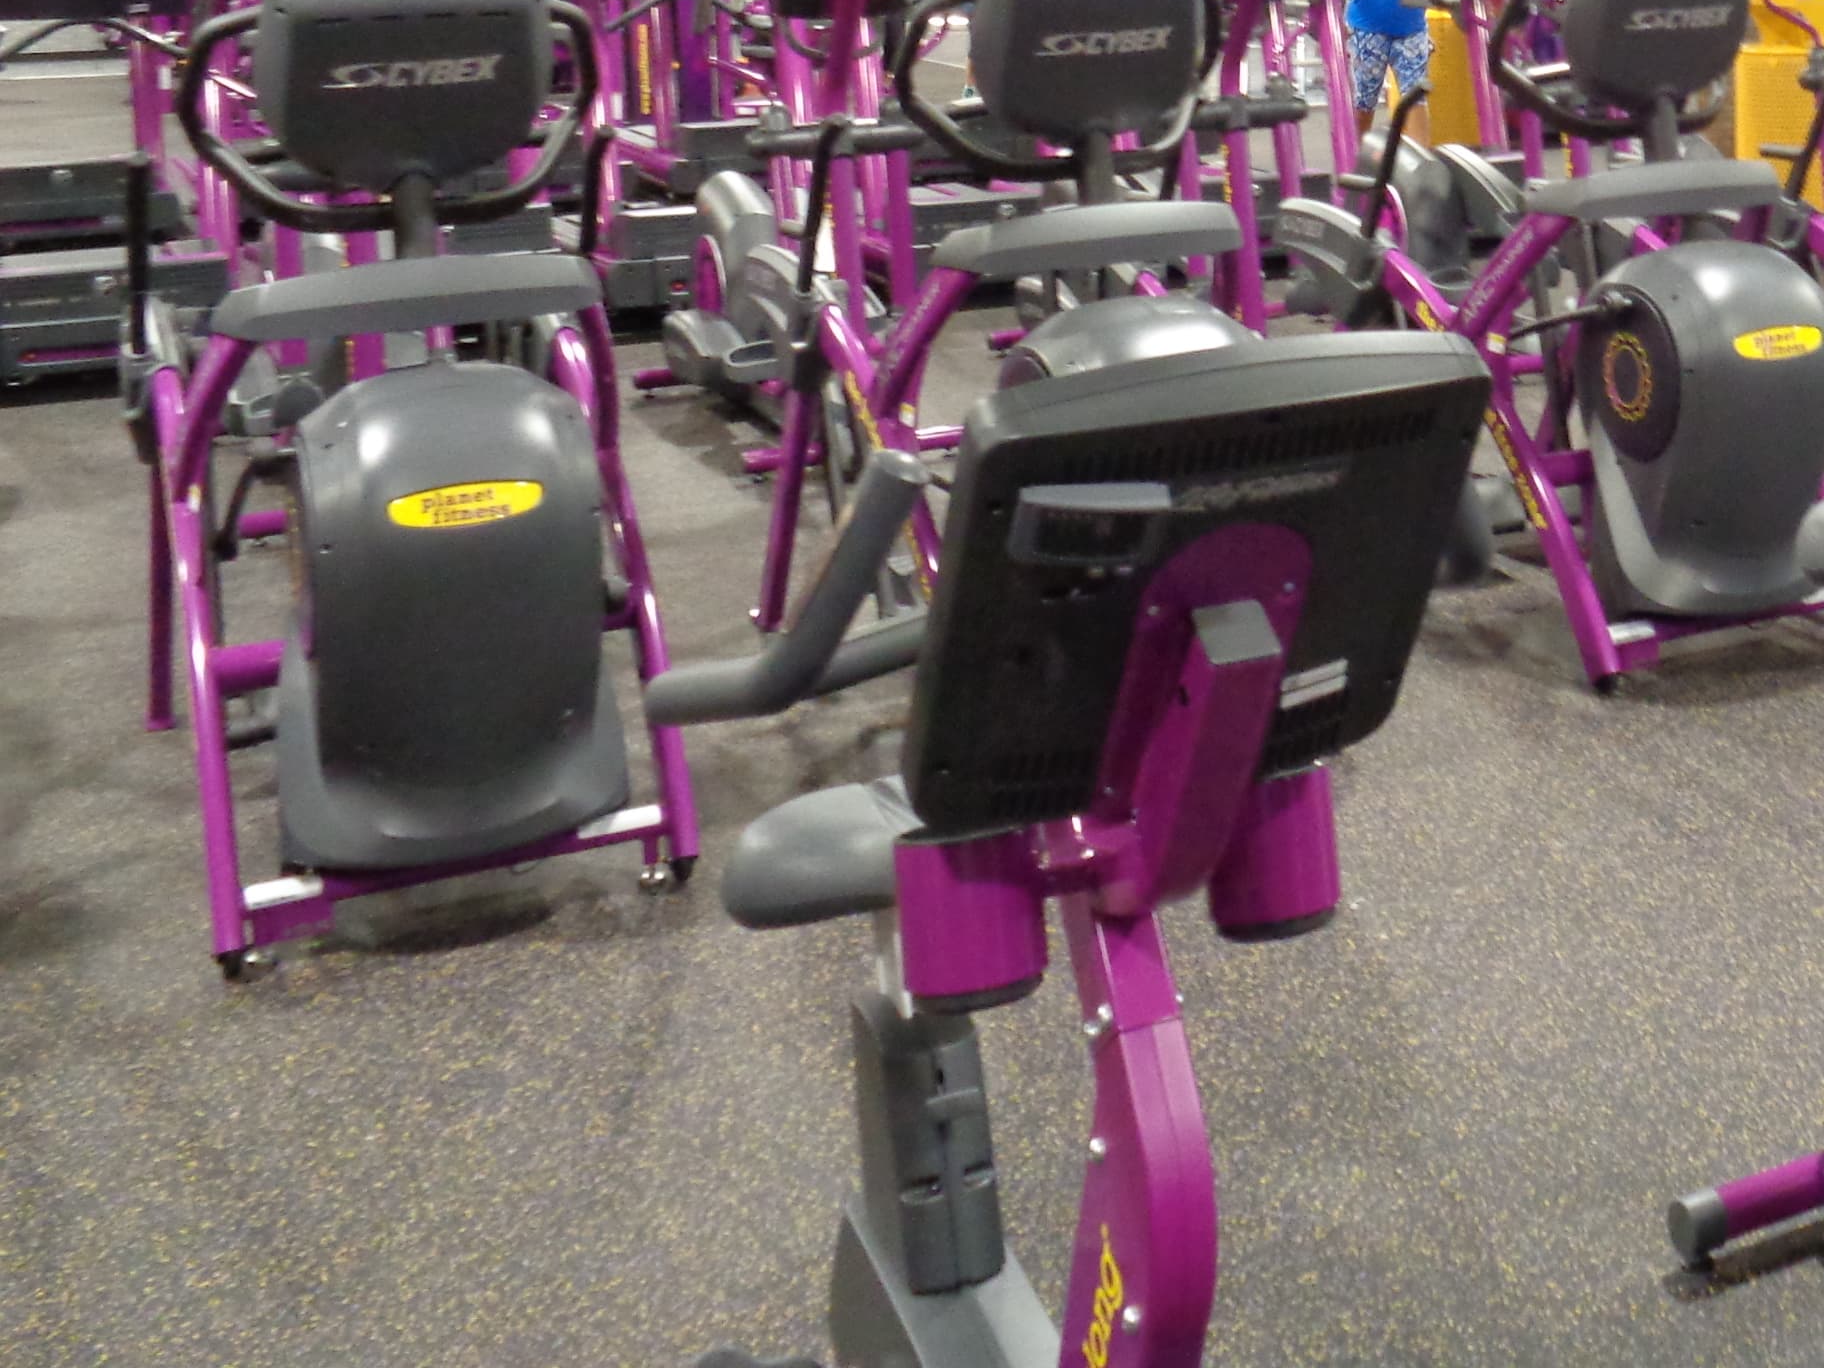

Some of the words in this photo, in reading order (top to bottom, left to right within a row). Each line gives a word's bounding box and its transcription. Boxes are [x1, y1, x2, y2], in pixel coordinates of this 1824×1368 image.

[386, 53, 504, 88] CYBEX
[421, 488, 494, 514] planet
[432, 503, 511, 525] fitness
